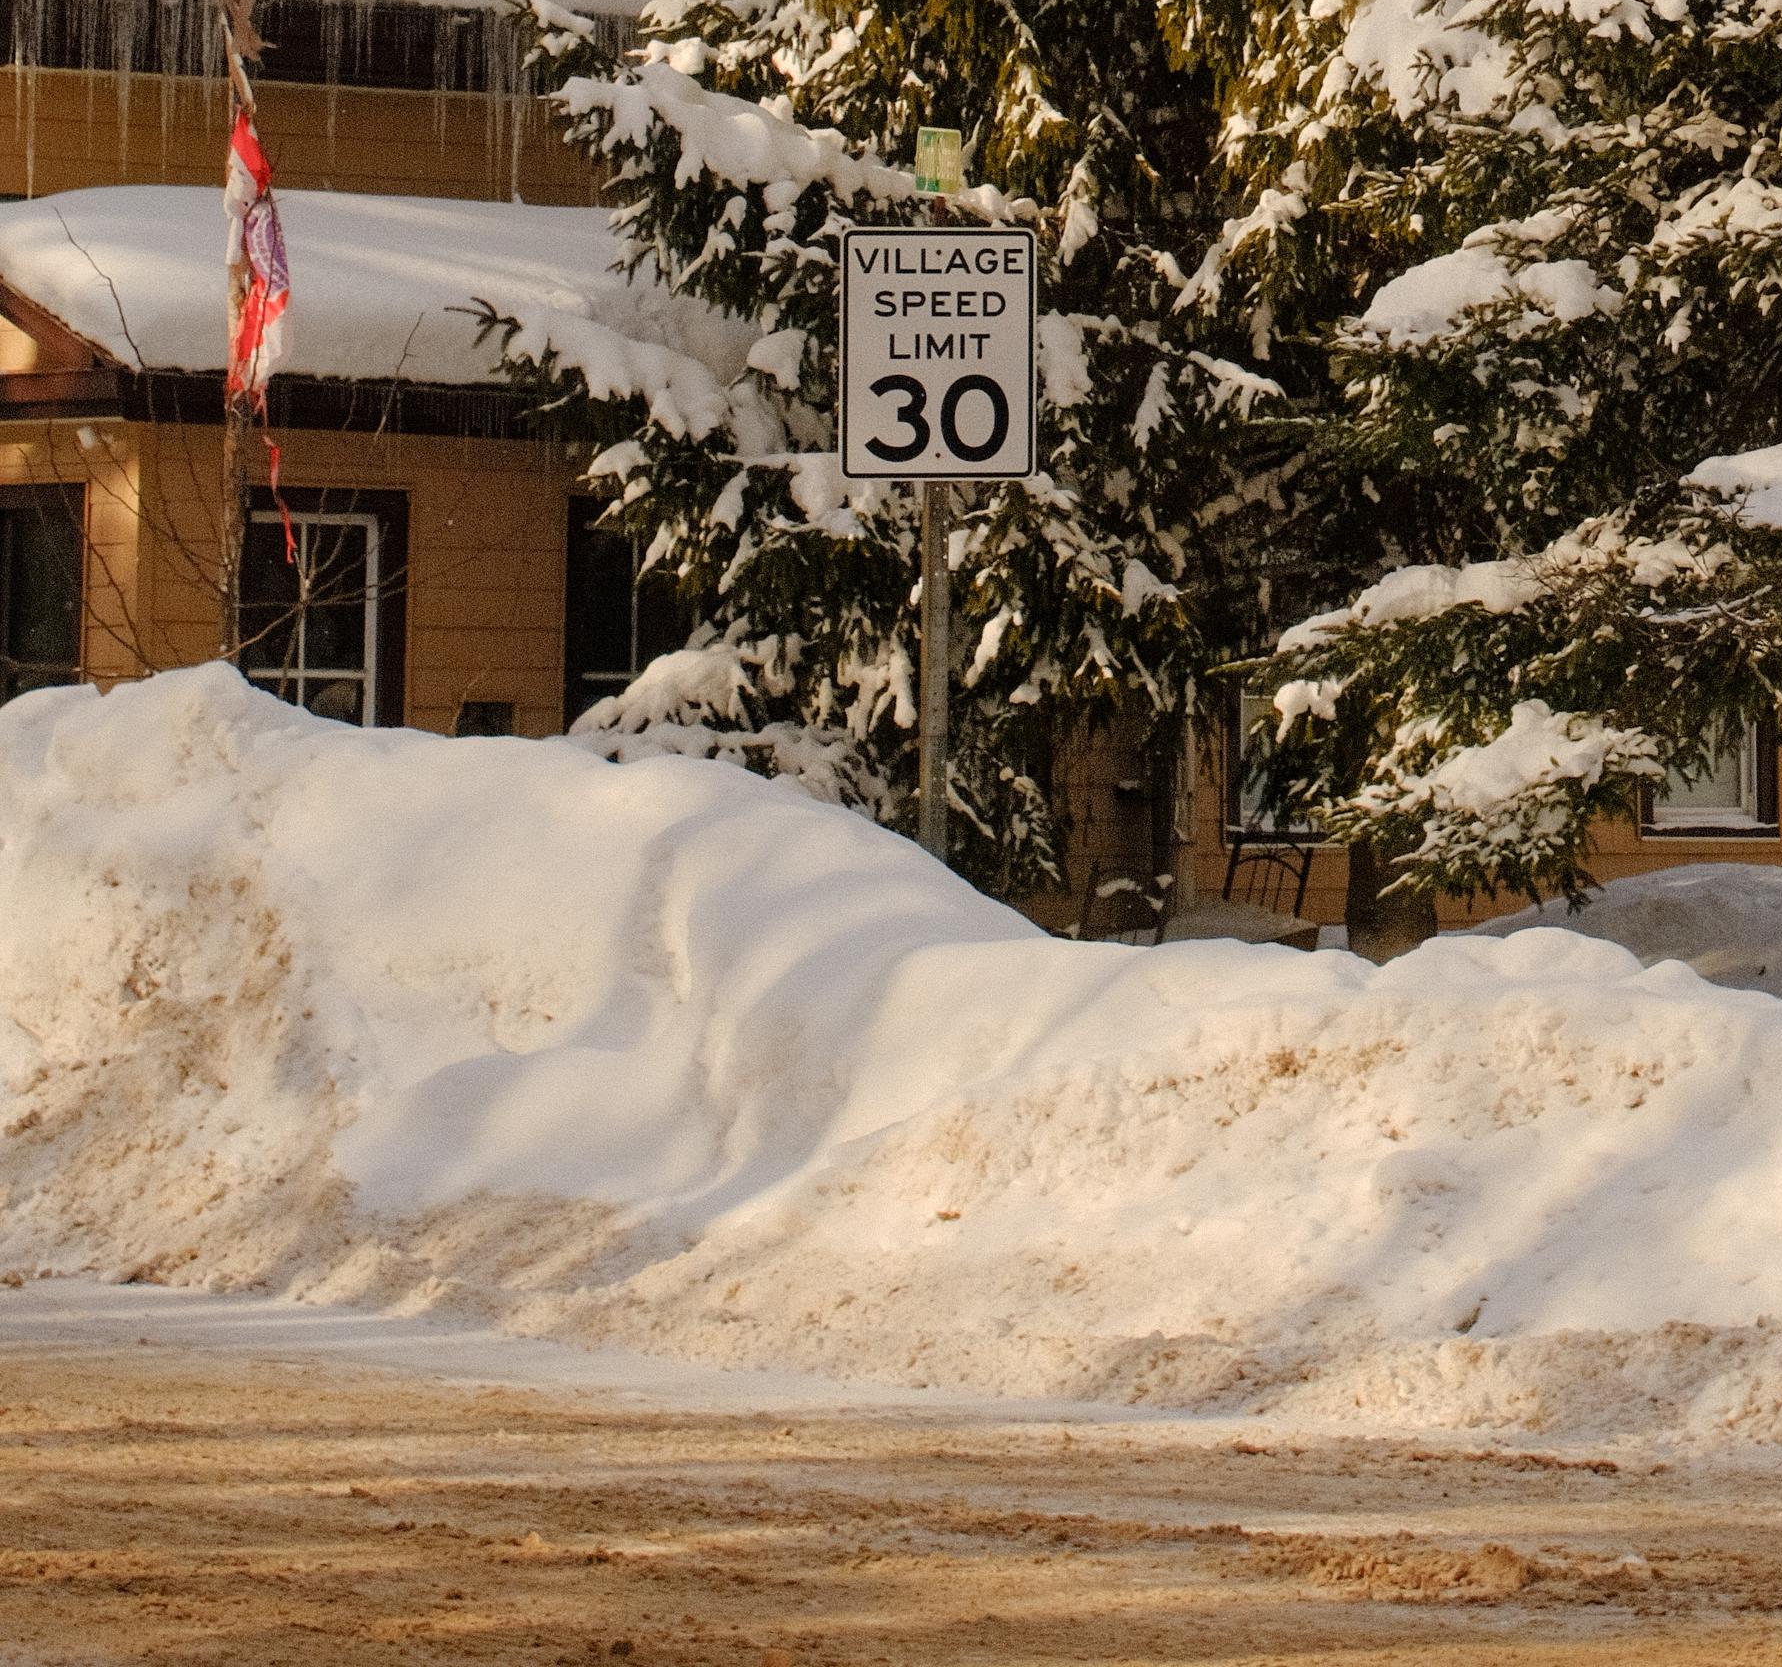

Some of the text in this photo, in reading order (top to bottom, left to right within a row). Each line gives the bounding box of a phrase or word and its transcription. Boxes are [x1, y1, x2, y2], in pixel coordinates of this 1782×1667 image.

[854, 248, 1024, 274] VILLAGE
[874, 291, 1006, 317] SPEED
[889, 334, 990, 359] LIMIT
[865, 374, 1009, 462] 30
